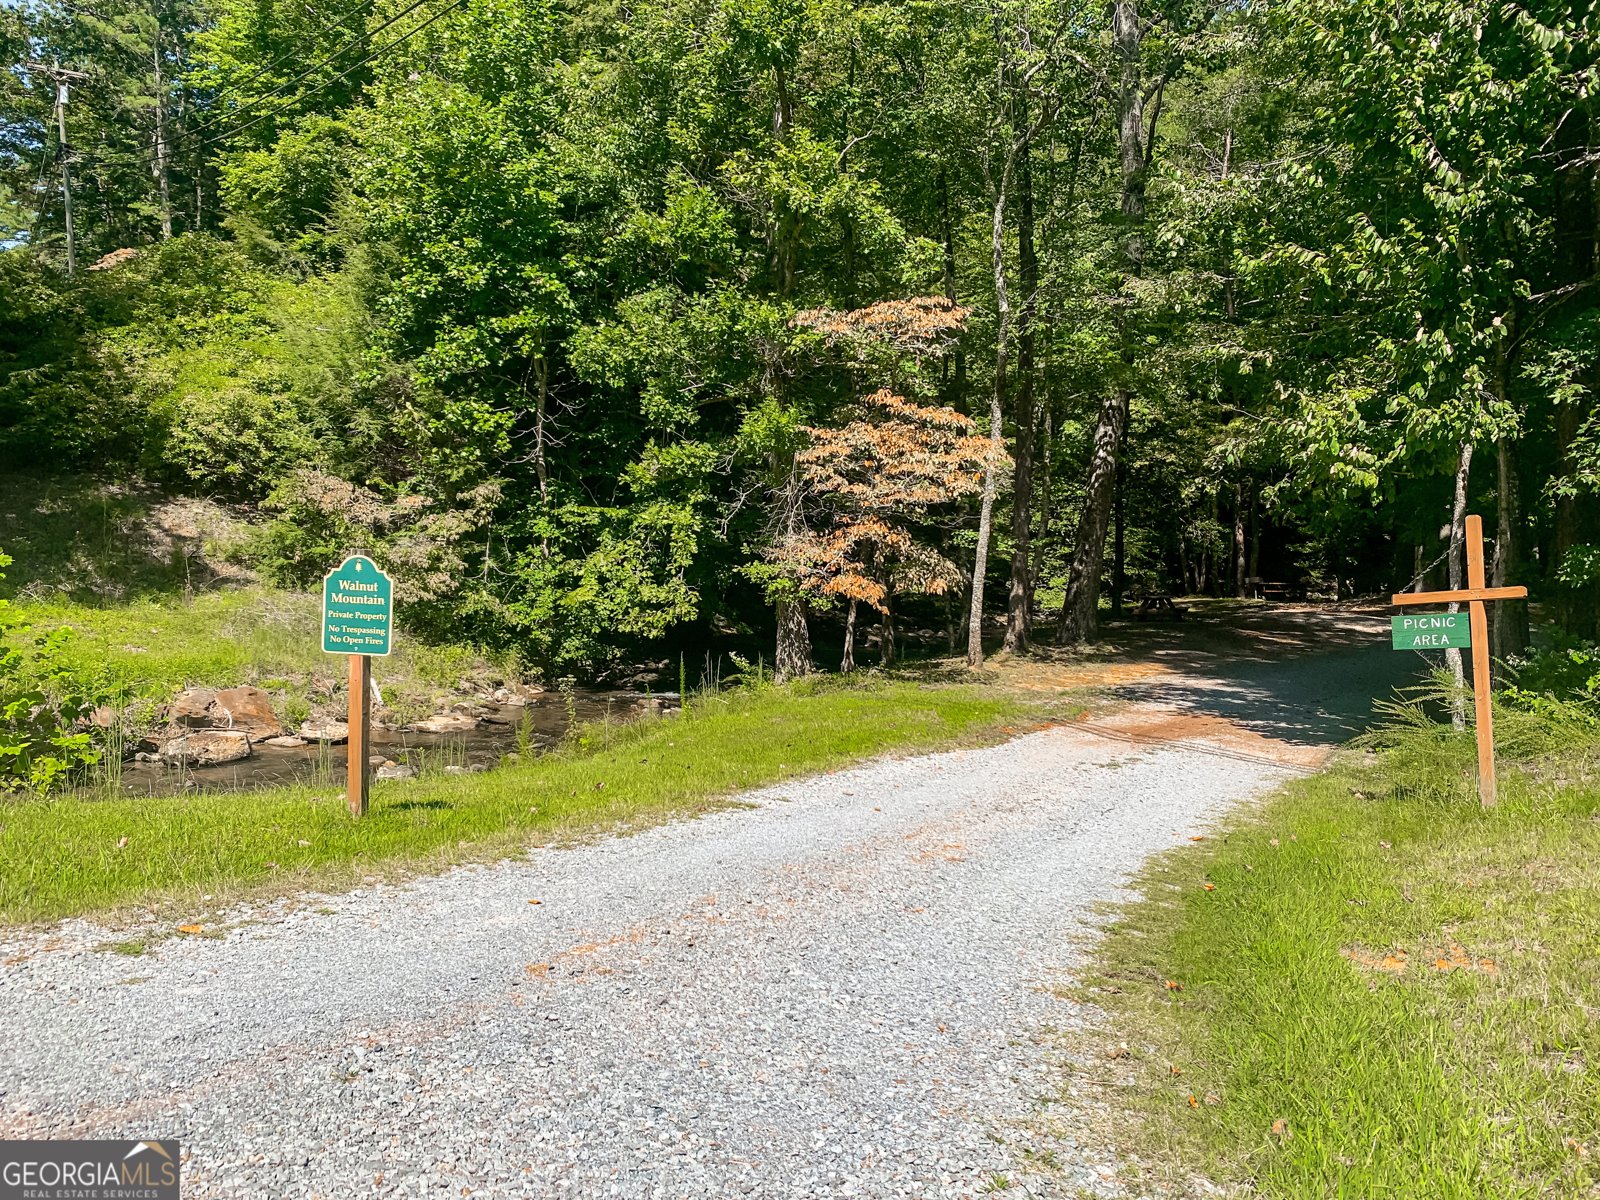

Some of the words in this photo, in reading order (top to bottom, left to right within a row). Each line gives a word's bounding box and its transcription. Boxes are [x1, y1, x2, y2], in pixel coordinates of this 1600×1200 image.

[338, 580, 378, 592] Walnut
[331, 593, 385, 605] Mountain
[328, 610, 353, 619] Private
[355, 611, 387, 622] Property
[1403, 617, 1456, 629] PICNIC
[328, 624, 339, 632] No
[341, 625, 386, 636] Trespassing
[329, 635, 341, 643] No
[342, 636, 363, 645] Open
[365, 636, 384, 645] Fires
[1413, 634, 1450, 646] AREA
